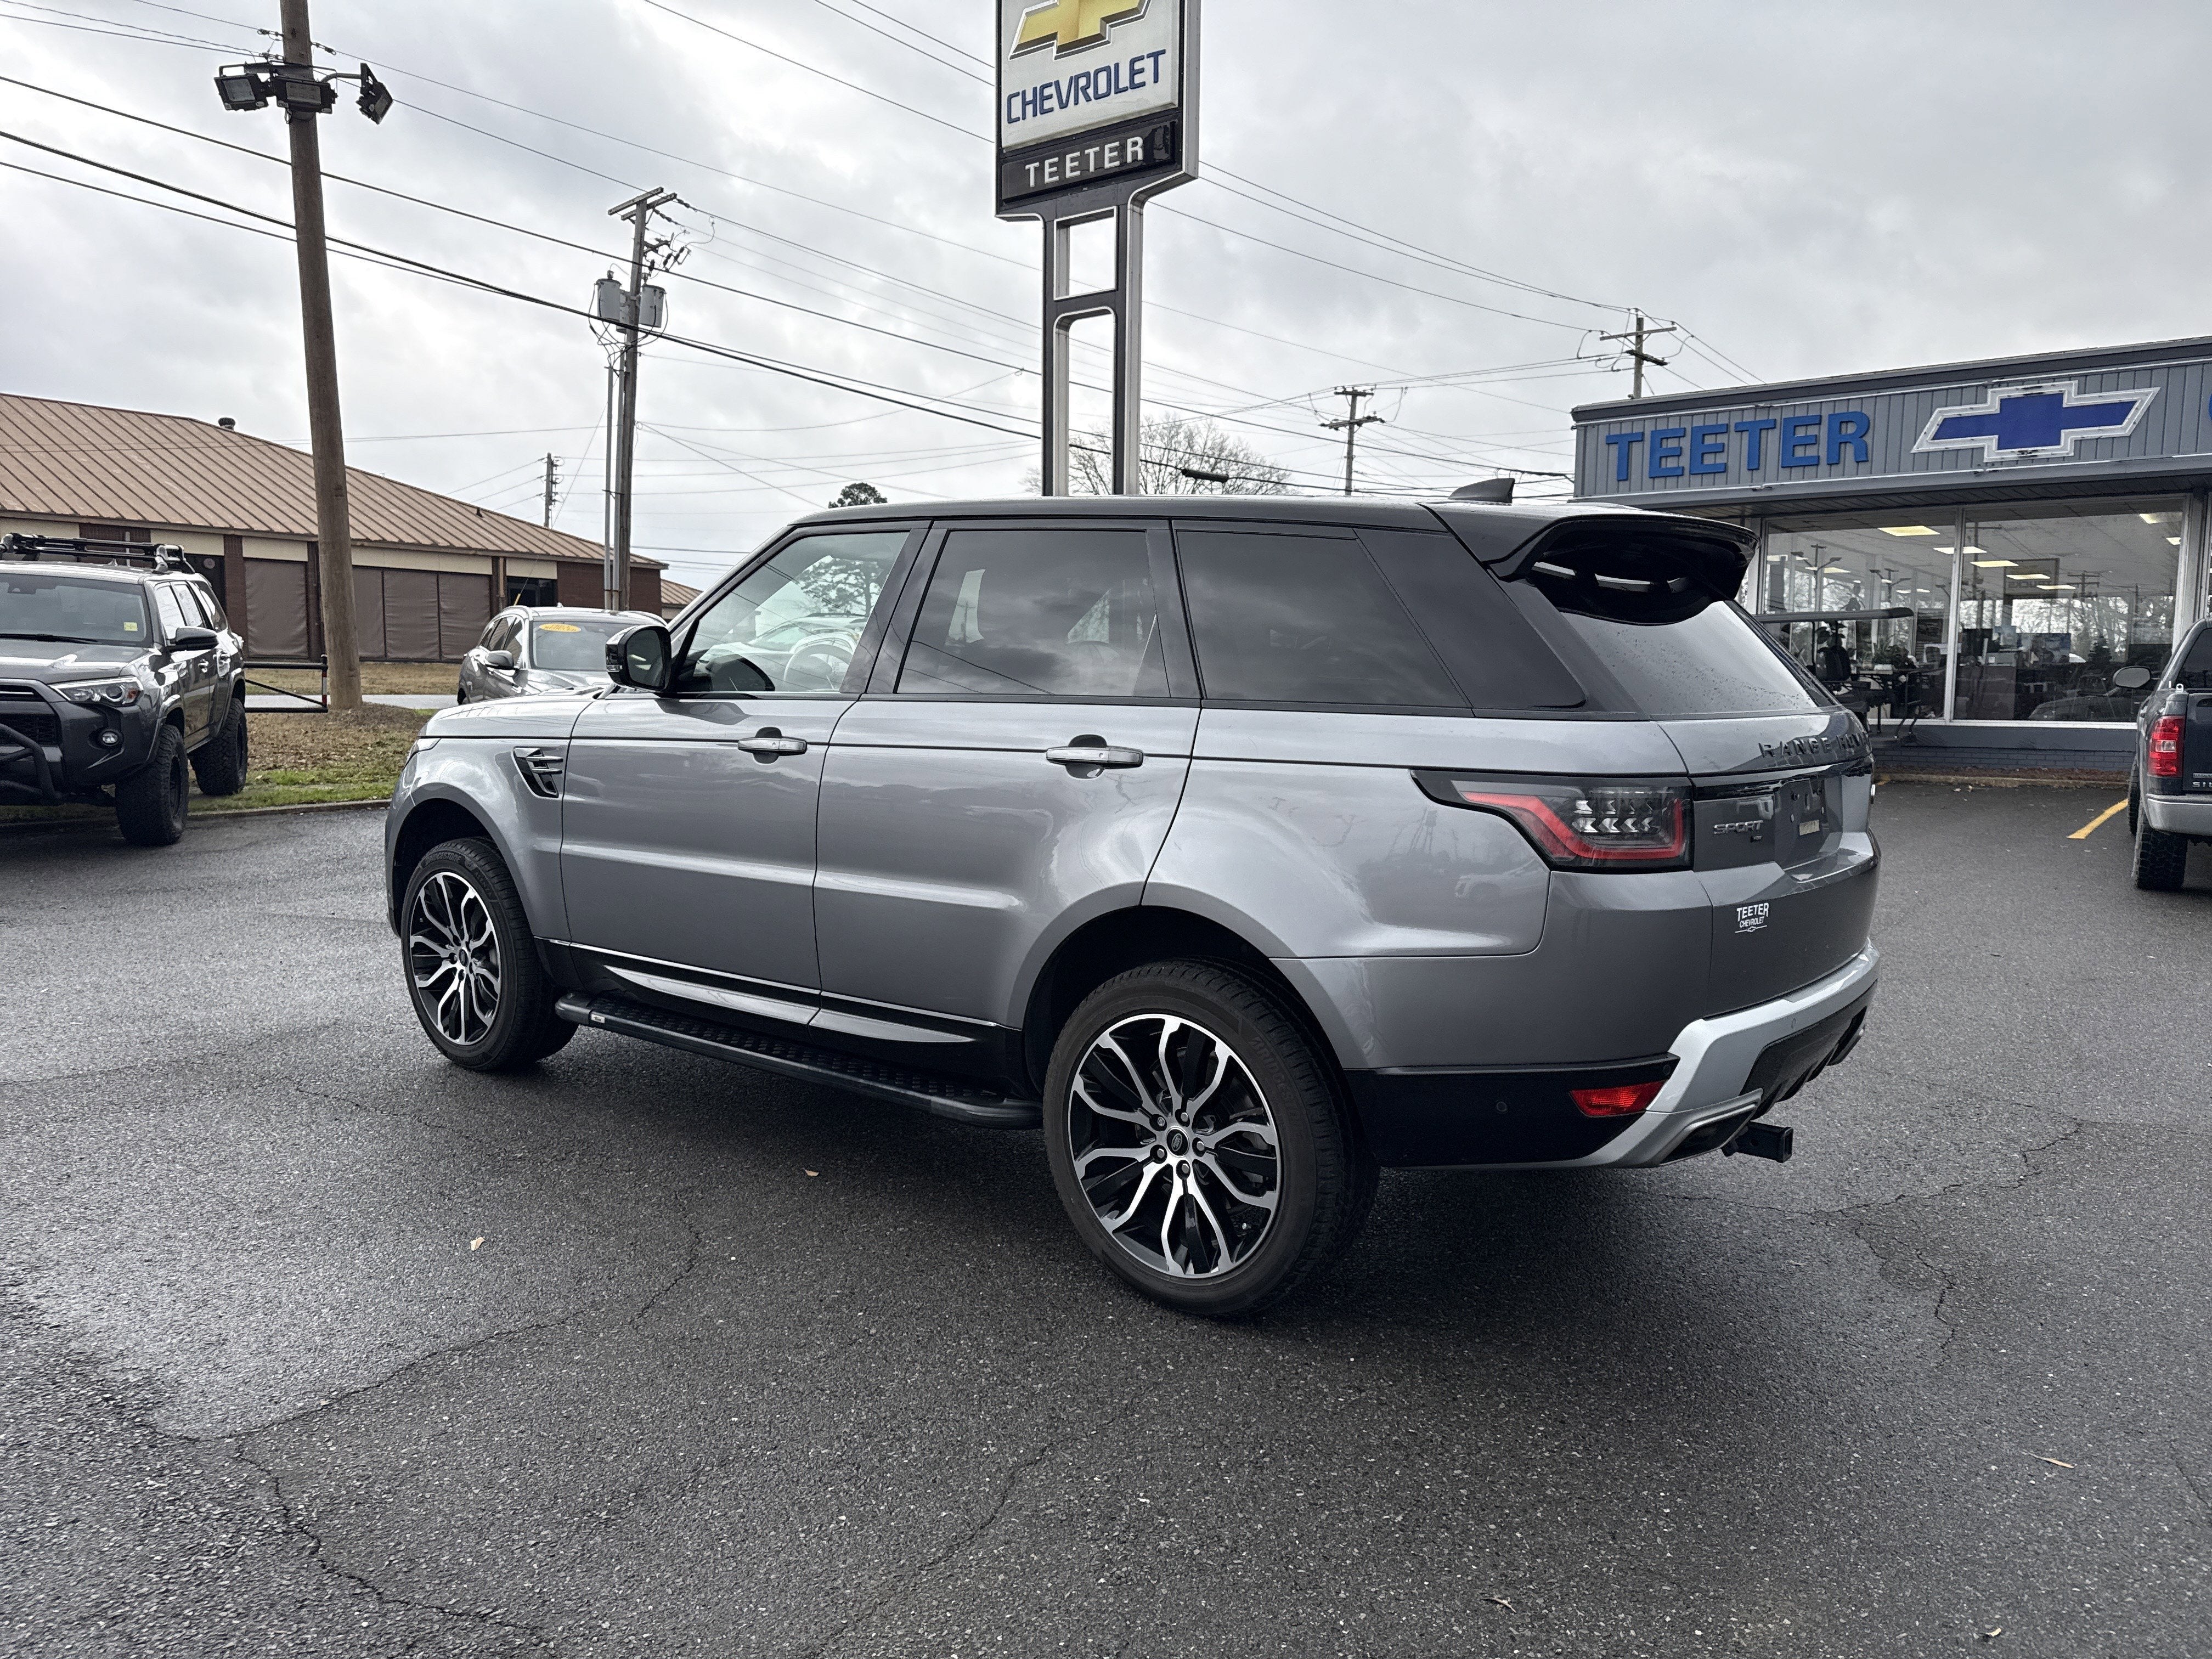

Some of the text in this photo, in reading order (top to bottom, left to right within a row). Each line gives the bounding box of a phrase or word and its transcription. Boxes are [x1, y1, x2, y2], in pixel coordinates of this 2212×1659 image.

[1007, 49, 1166, 124] CHEVROLET
[1025, 136, 1143, 188] TEETER
[1606, 411, 1870, 481] TEETER
[1758, 732, 1866, 758] RANGE ROV
[1713, 820, 1763, 834] SPORT
[1736, 902, 1769, 922] TEETER
[1740, 916, 1764, 928] CHEVROLET
